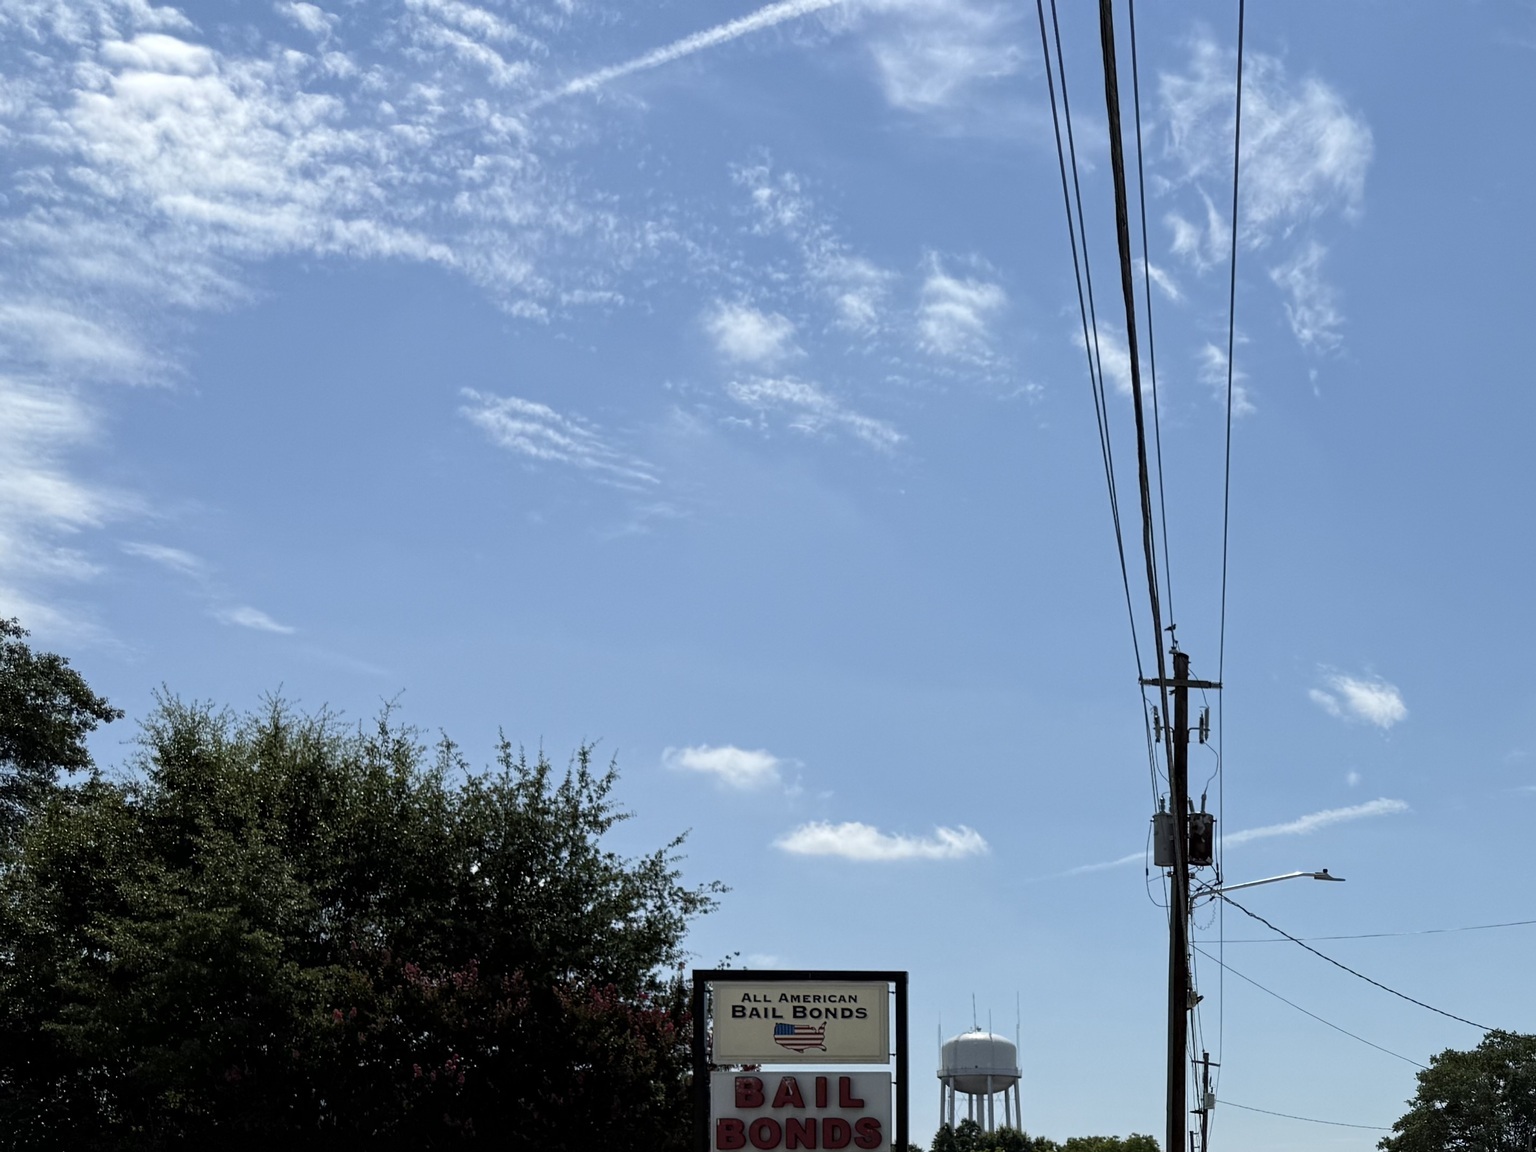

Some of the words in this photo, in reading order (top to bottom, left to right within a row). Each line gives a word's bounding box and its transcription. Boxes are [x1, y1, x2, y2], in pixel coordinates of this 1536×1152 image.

[741, 993, 772, 1003] ALL
[780, 993, 858, 1003] AMERICAN
[732, 1005, 784, 1019] BAIL
[792, 1005, 868, 1019] BONDS
[734, 1076, 865, 1109] BAIL
[716, 1117, 882, 1150] BONDS
